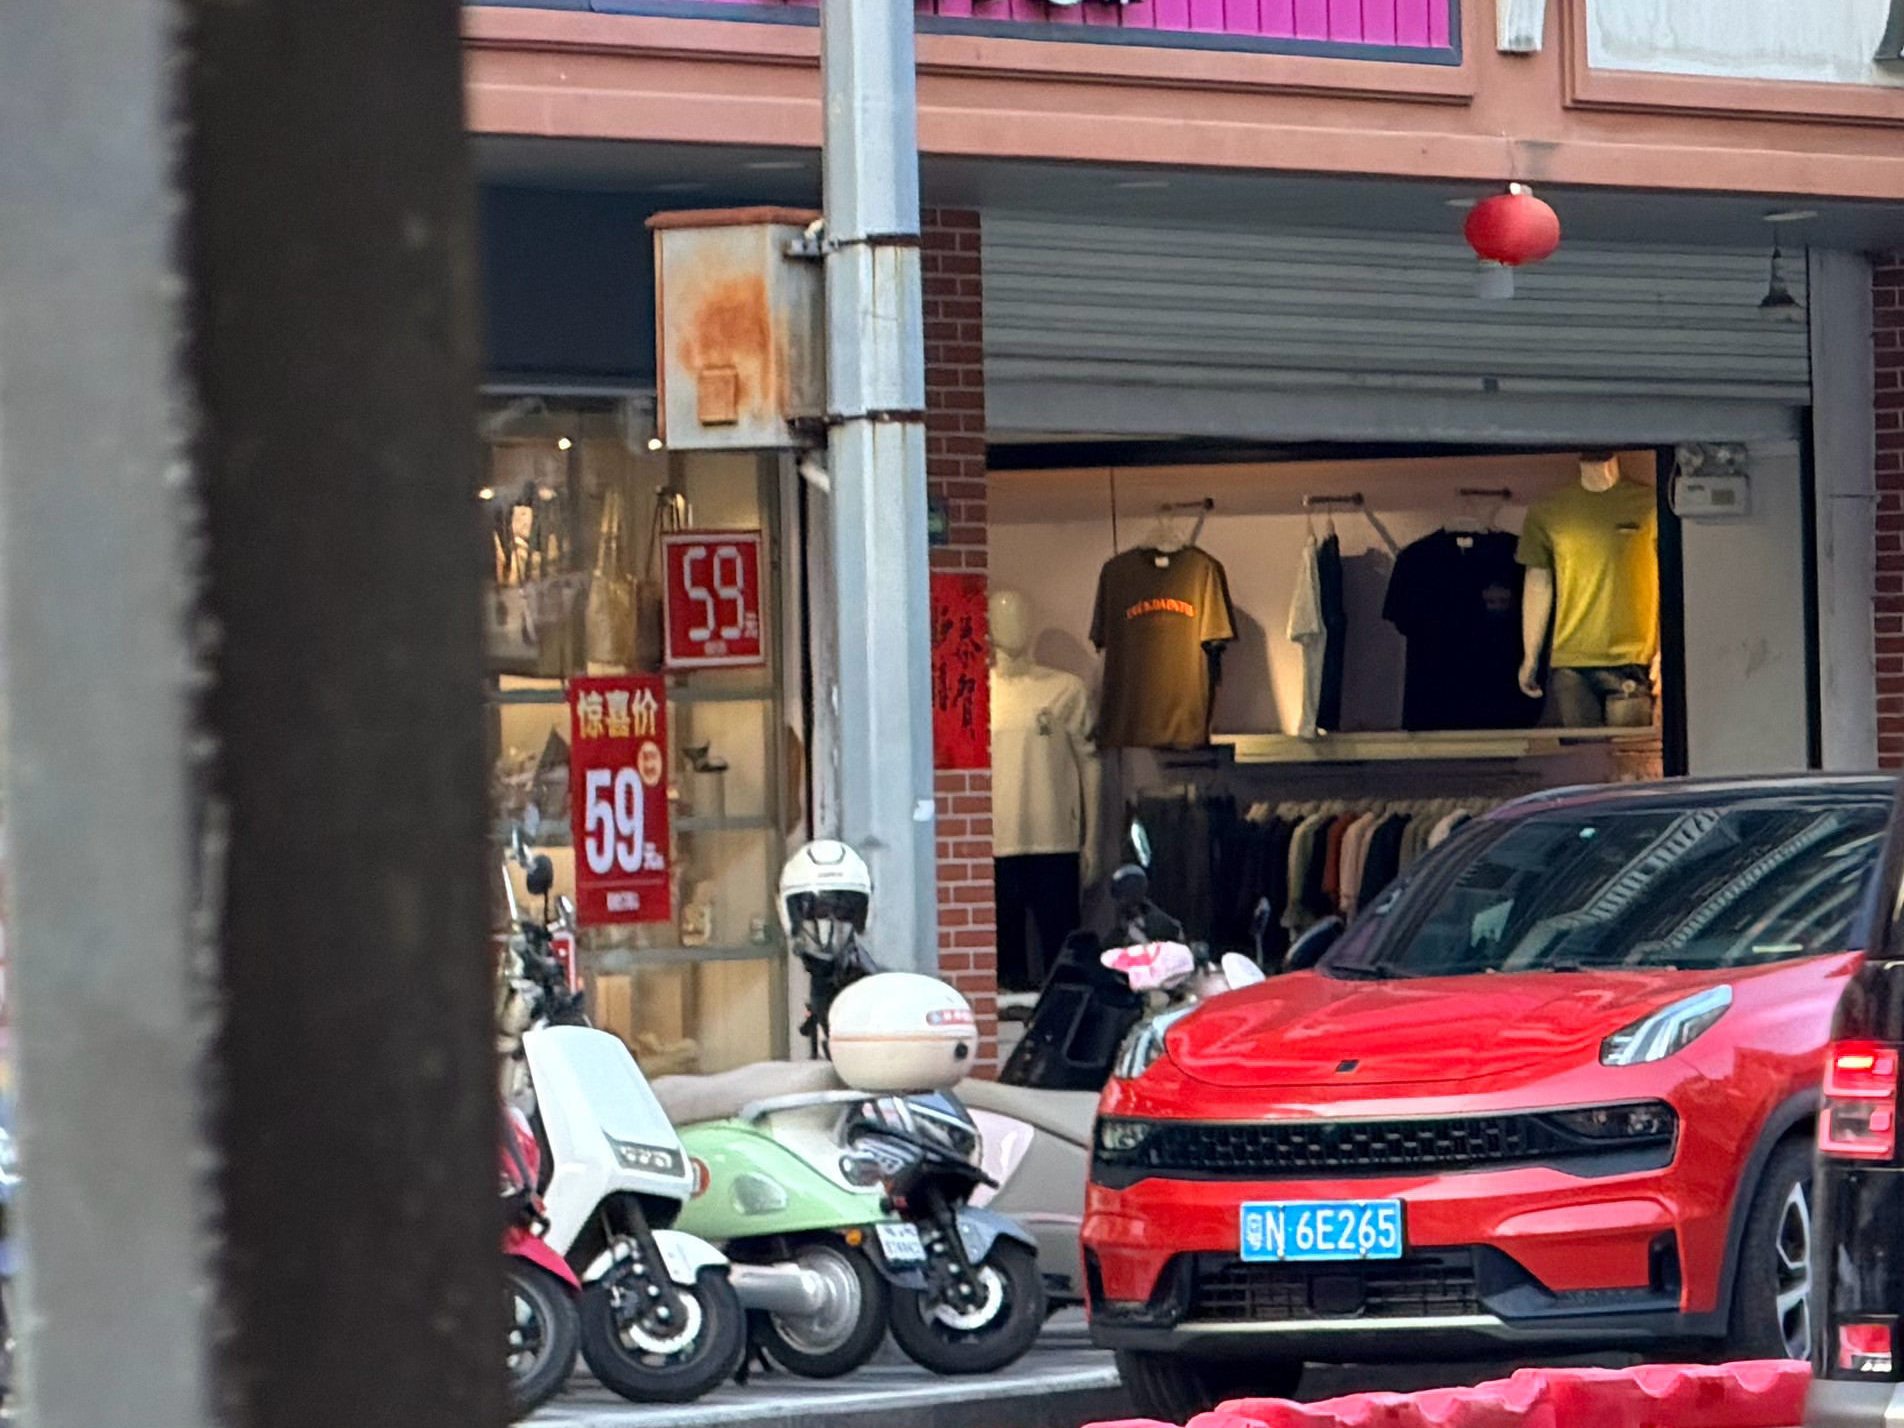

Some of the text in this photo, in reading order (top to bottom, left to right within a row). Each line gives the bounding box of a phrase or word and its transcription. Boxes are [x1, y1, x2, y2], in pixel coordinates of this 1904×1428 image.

[683, 545, 744, 643] 59
[577, 688, 659, 740] 惊喜价
[584, 766, 645, 874] 59
